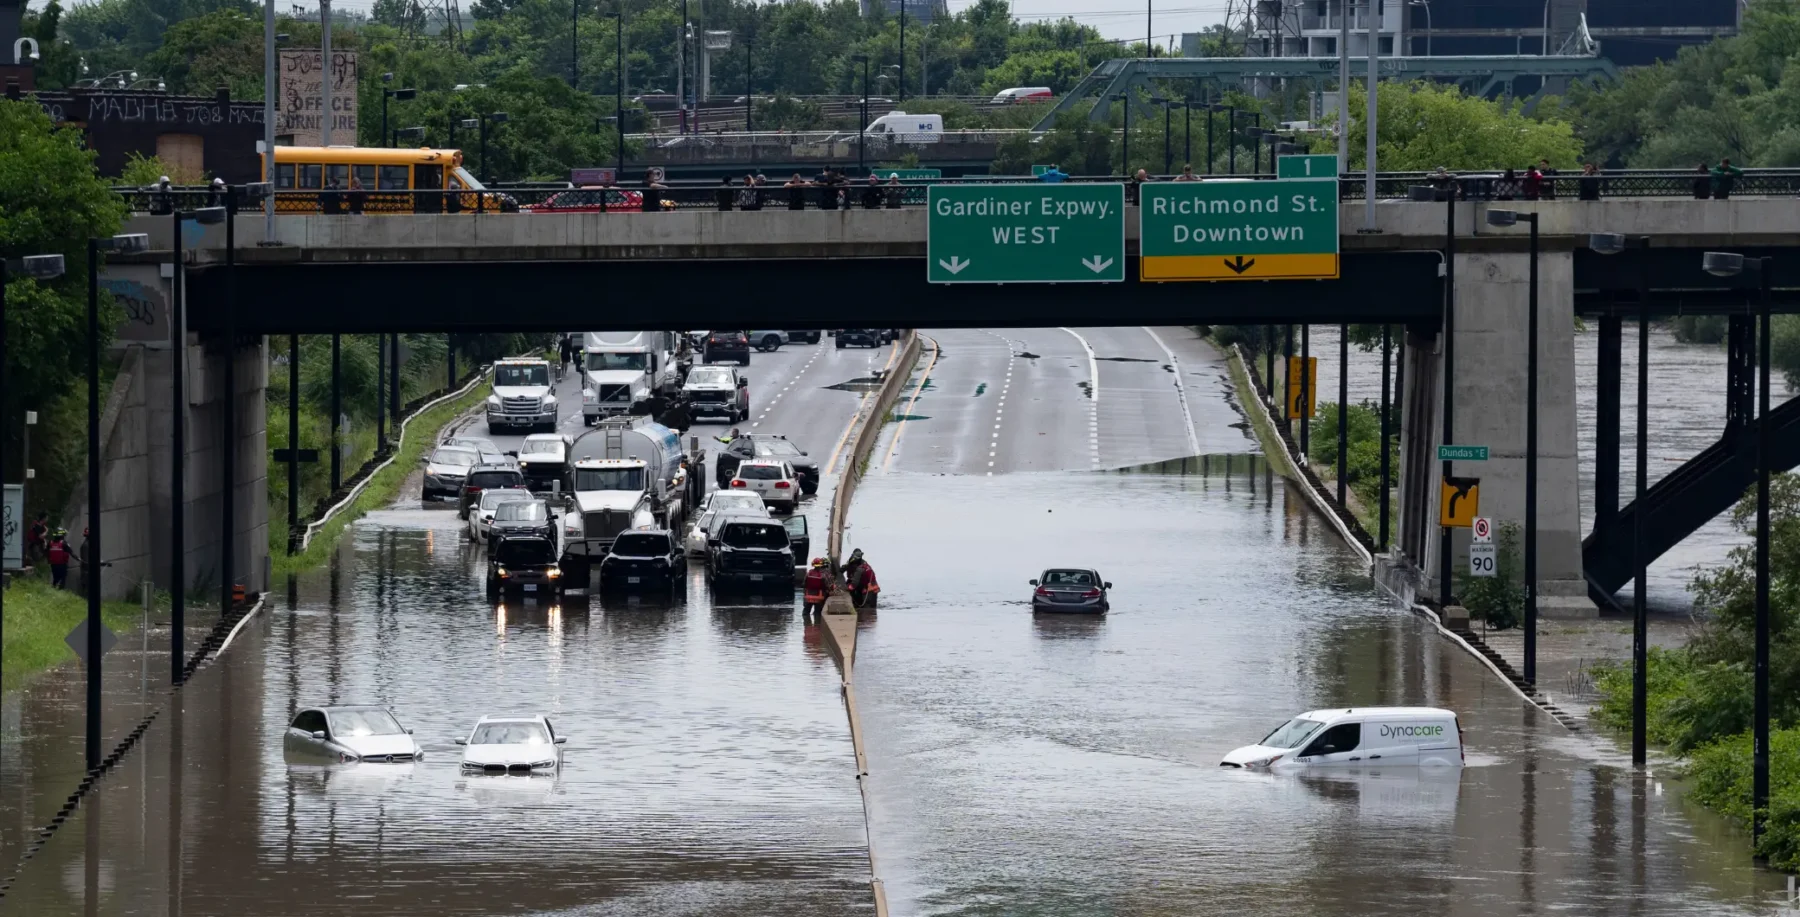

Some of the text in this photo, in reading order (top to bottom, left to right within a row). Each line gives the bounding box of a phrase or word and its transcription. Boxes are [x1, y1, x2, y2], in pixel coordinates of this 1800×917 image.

[282, 53, 356, 76] JOSPH
[294, 97, 353, 111] OFFCE
[1304, 158, 1311, 176] 1
[936, 197, 1114, 219] Gardiner Expwy.
[1153, 195, 1325, 215] Richmond St.
[992, 226, 1060, 244] WEST
[1173, 224, 1304, 243] Downtown
[1441, 448, 1485, 458] Dundas E
[1472, 557, 1493, 571] 90
[1380, 724, 1444, 739] Dynacare
